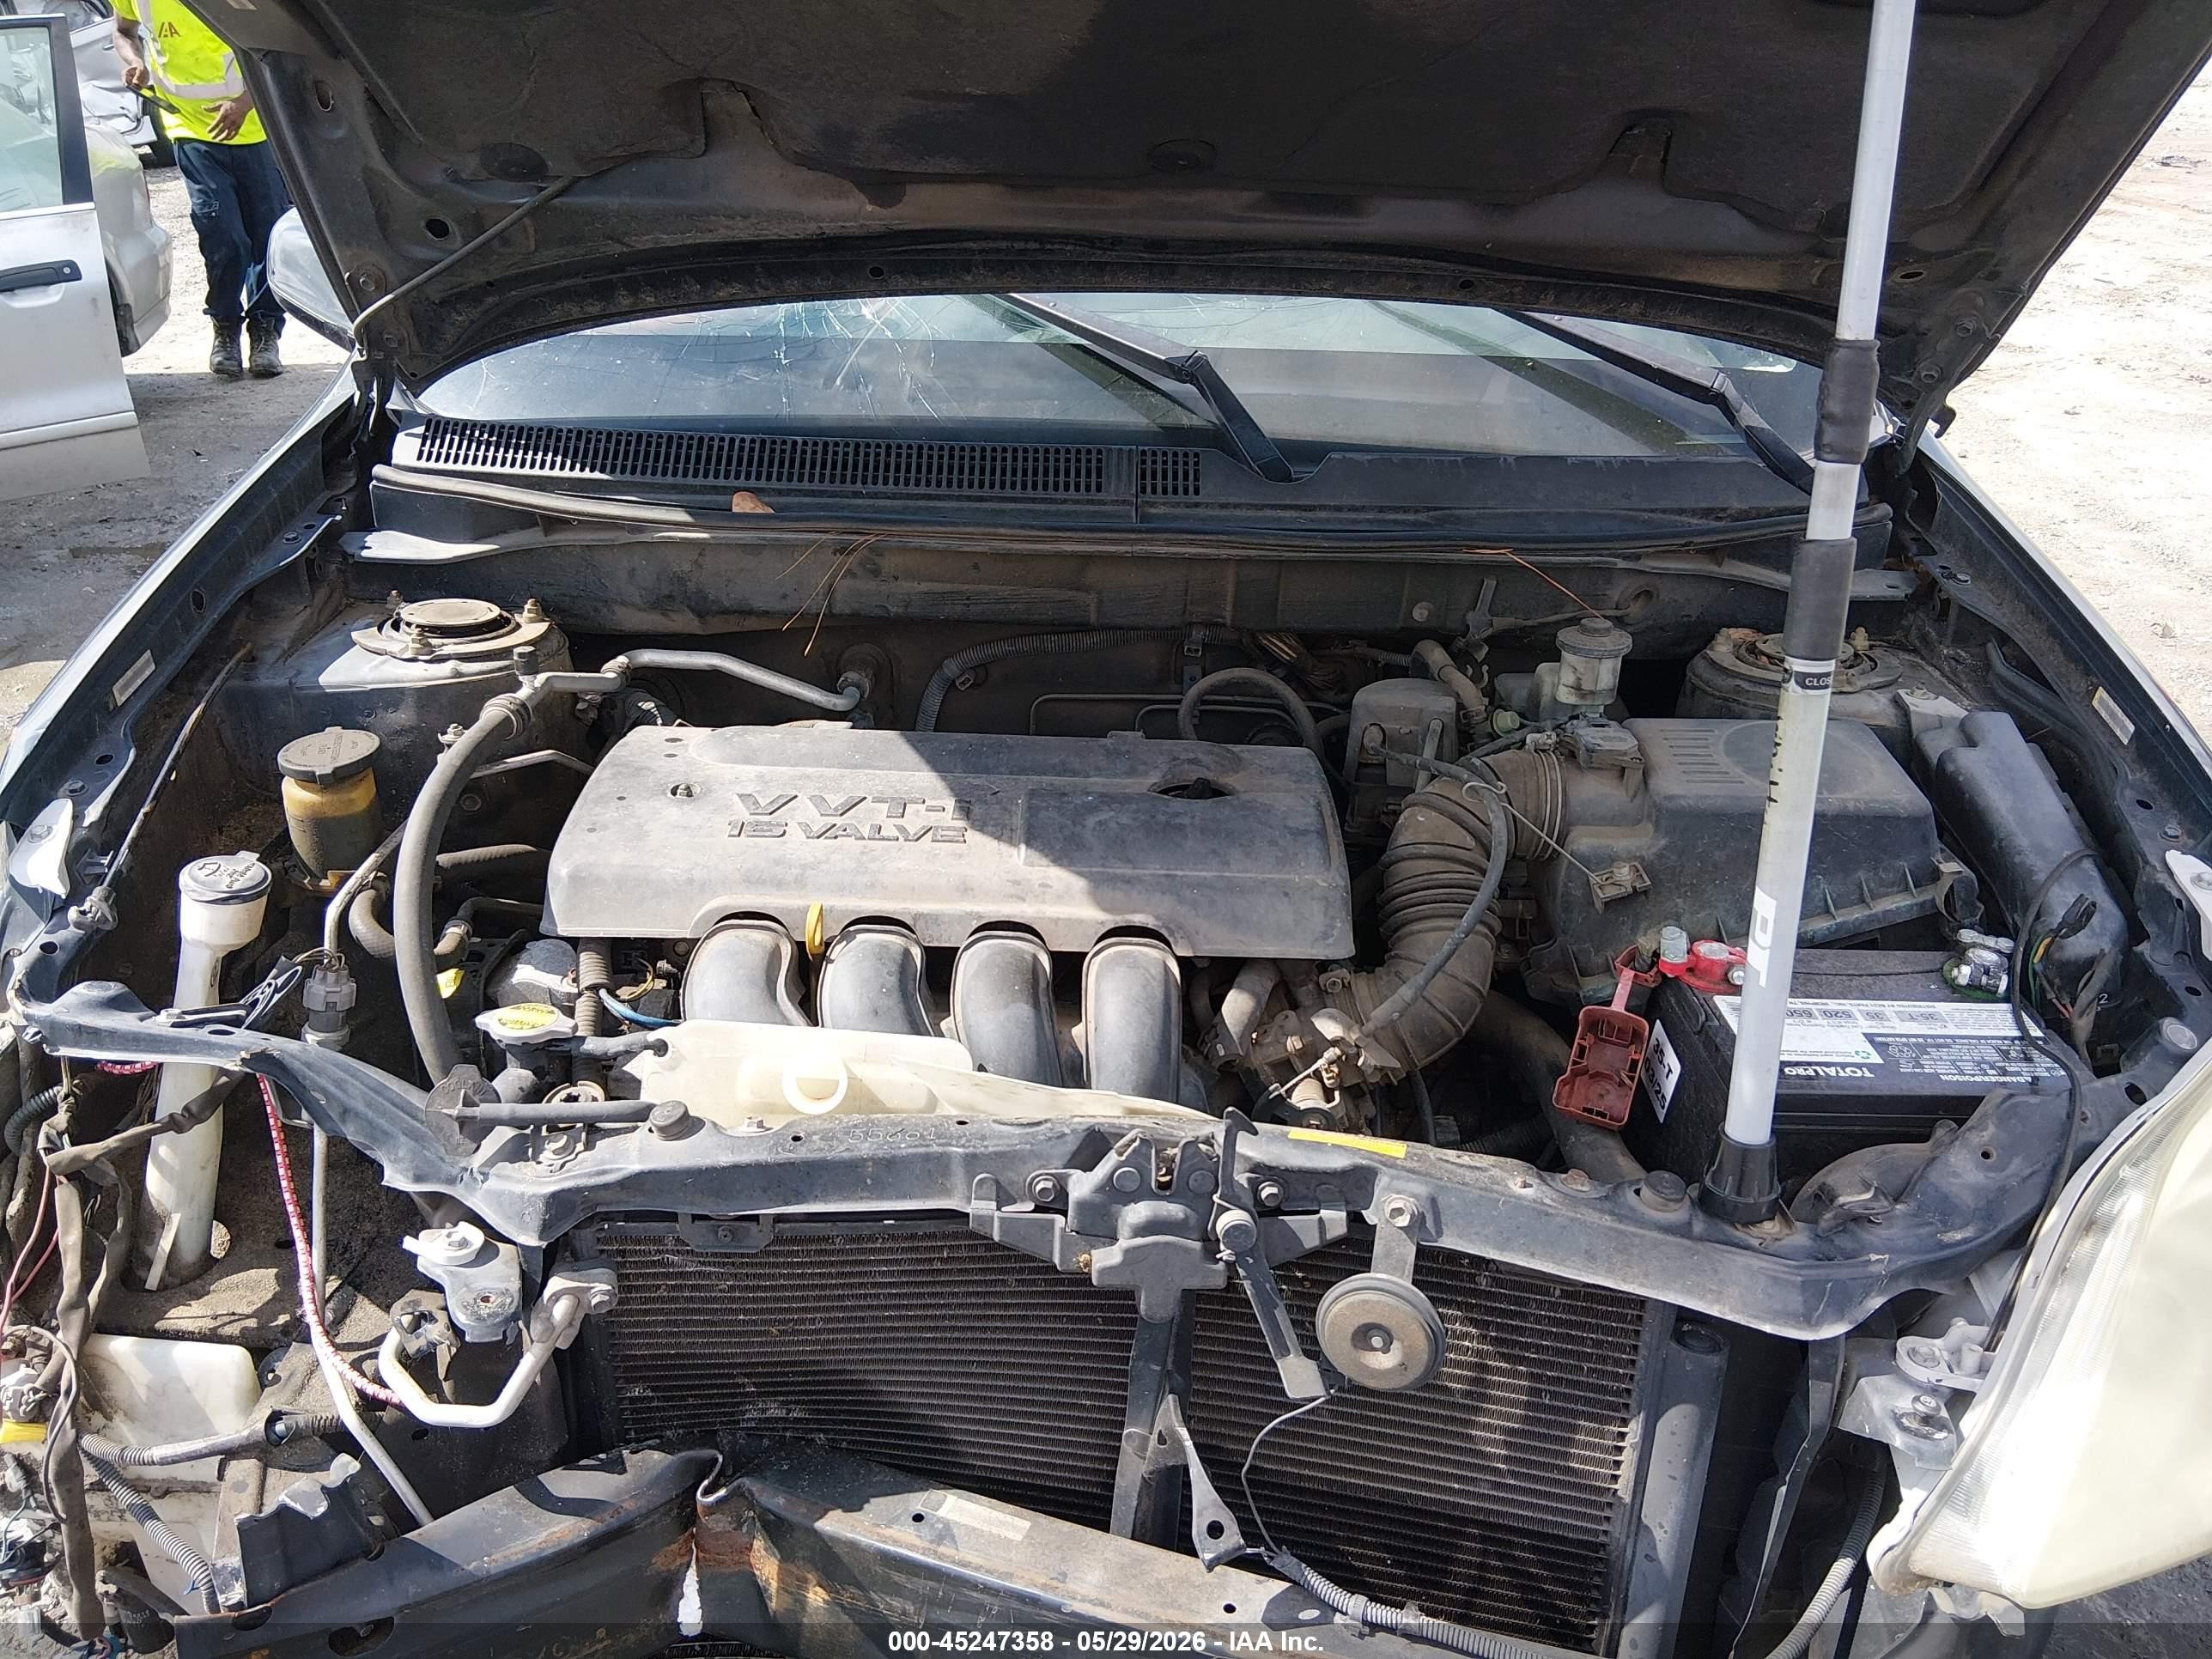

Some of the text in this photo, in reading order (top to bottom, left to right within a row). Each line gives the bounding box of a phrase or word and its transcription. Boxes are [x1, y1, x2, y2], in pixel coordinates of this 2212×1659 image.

[726, 820, 968, 844] 16 VALVE
[1822, 1010, 1852, 1018] 520
[1907, 1012, 1938, 1021] 35-T
[1653, 1037, 1673, 1080] 35-T
[1784, 1066, 1875, 1078] TOTALPRO
[1644, 1057, 1667, 1110] 03/25
